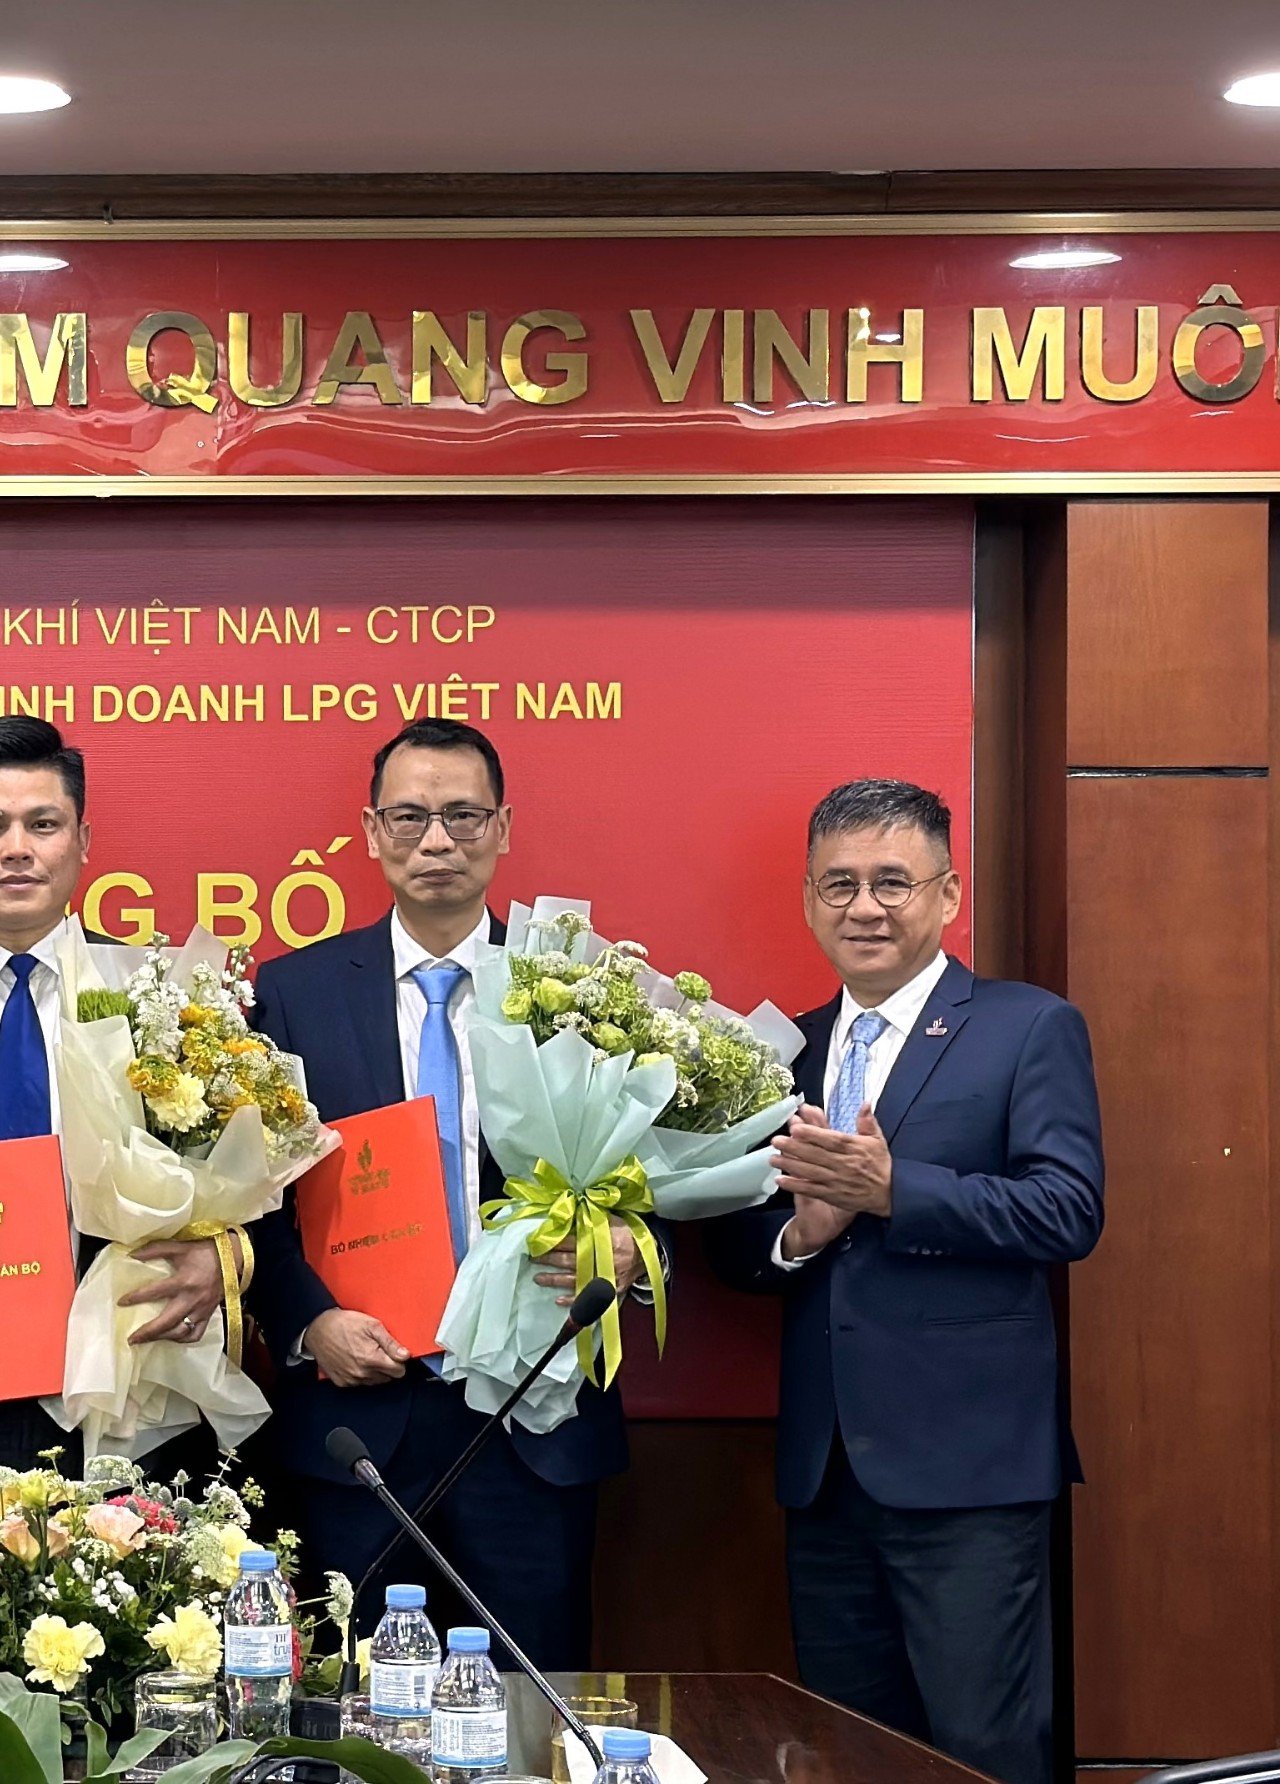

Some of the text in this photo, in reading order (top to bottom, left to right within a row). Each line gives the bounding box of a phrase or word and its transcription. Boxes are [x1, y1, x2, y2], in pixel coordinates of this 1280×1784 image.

[124, 309, 589, 414] QUANG
[629, 306, 925, 404] VINH
[972, 283, 1280, 404] MUÔ
[3, 599, 80, 645] KHÍ
[96, 598, 201, 655] VIỆT
[218, 607, 321, 645] NAM
[365, 606, 496, 644] CTCP
[93, 684, 265, 723] DOANH
[282, 683, 378, 722] LPG
[516, 682, 622, 720] NAM
[197, 836, 353, 949] BỐ
